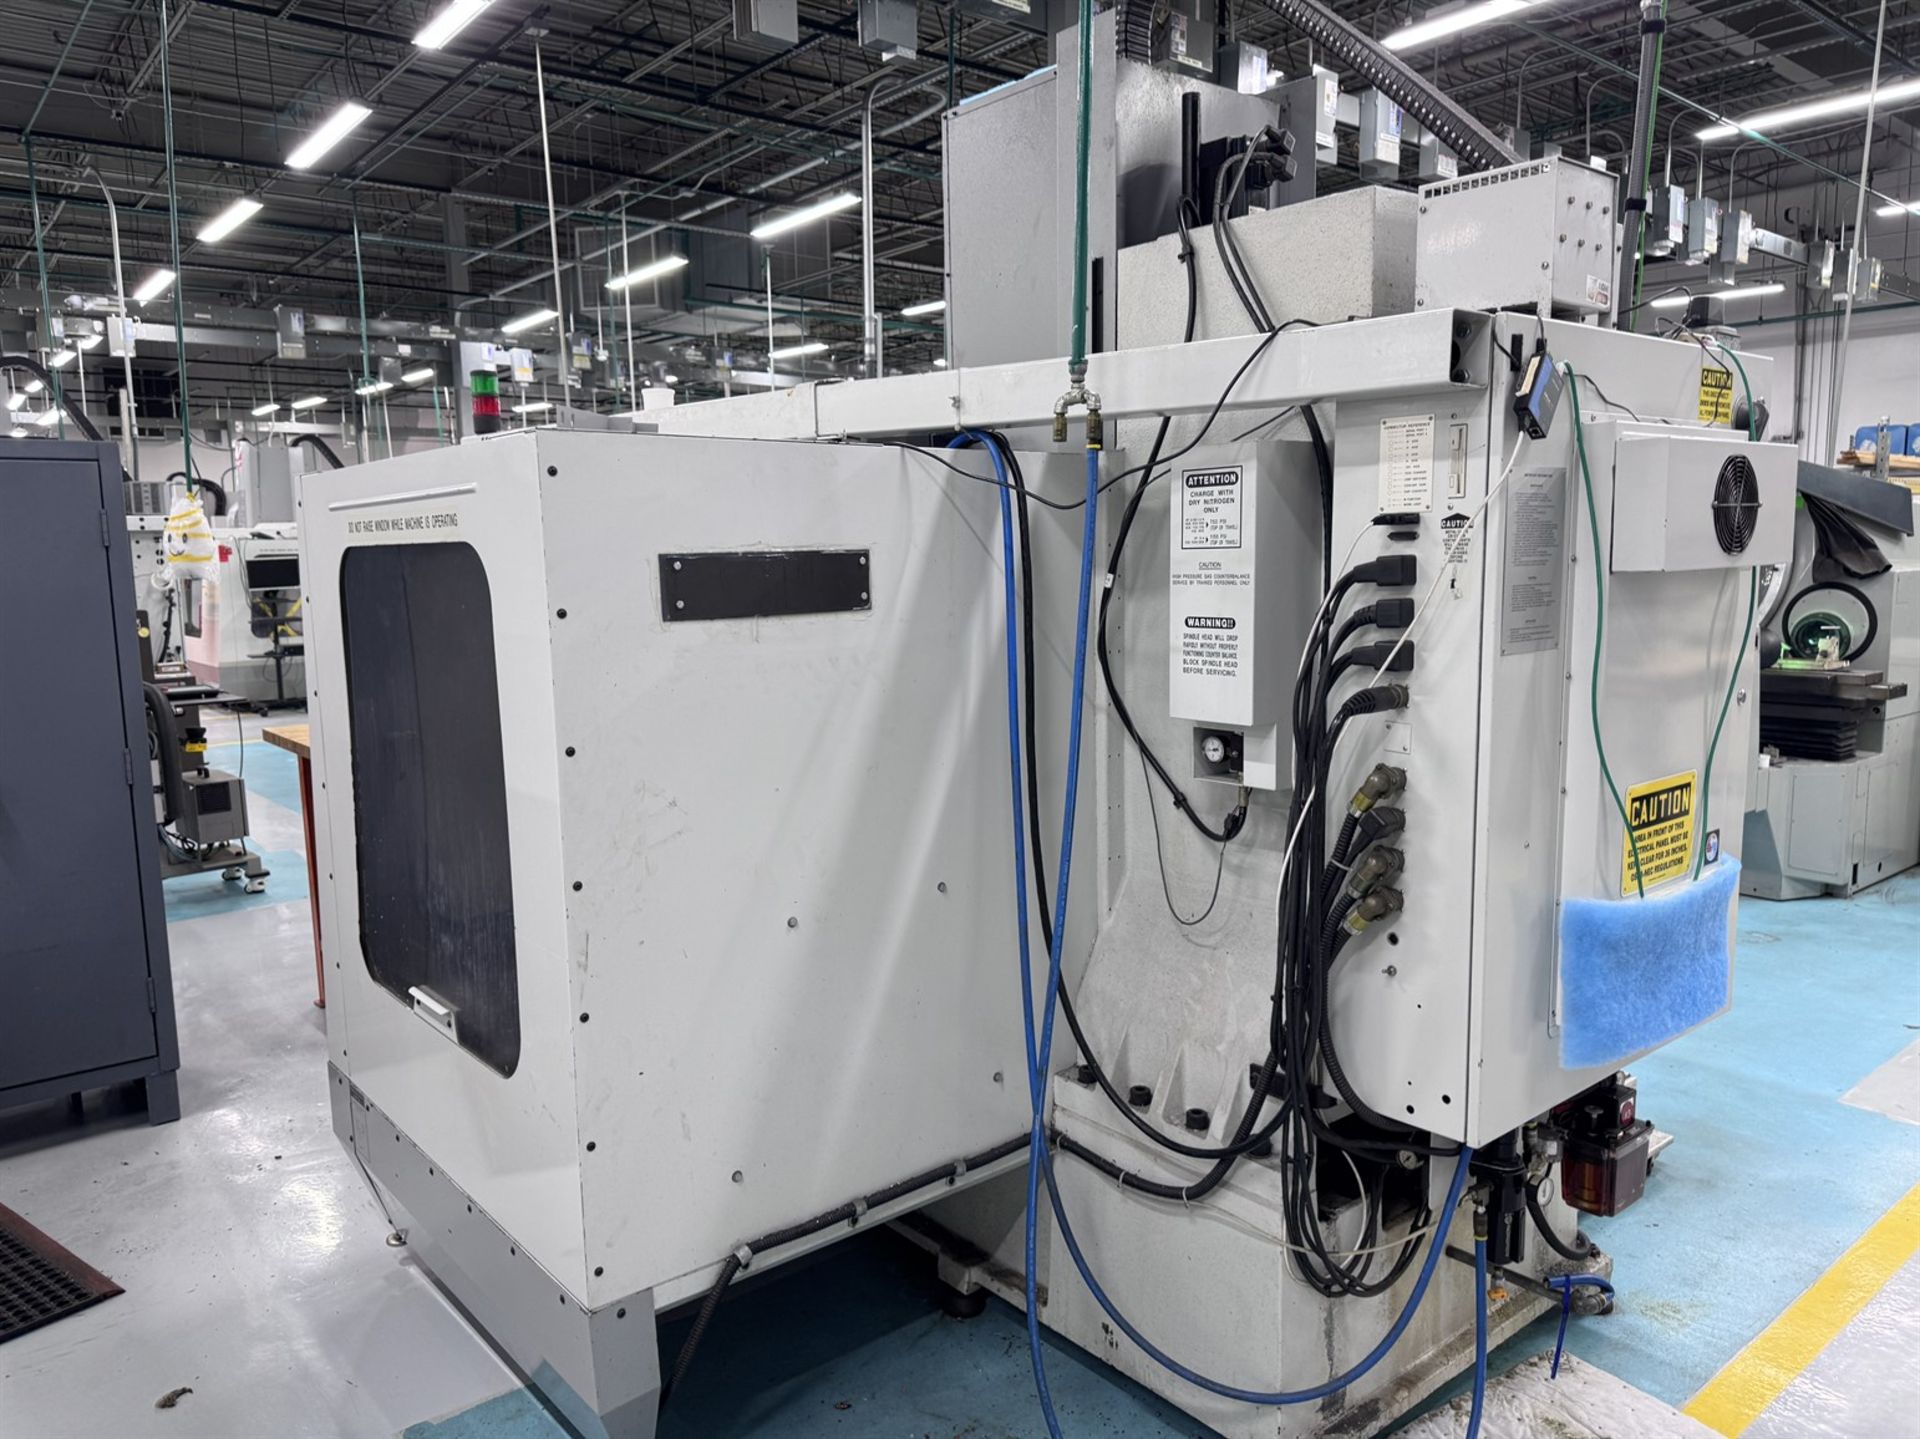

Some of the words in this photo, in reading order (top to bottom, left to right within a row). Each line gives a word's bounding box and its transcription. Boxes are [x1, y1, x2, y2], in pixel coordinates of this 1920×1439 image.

[1188, 473, 1236, 486] ATTENTION
[391, 518, 403, 531] WHILE
[405, 516, 424, 530] MACHINE
[425, 515, 430, 529] IS
[432, 513, 458, 528] OPERATING
[1187, 618, 1233, 627] WARNING!!
[1632, 786, 1690, 827] CAUTION
[1647, 830, 1652, 838] IN
[1653, 826, 1667, 836] FRONT
[1668, 824, 1673, 833] OF
[1675, 821, 1684, 830] THIS
[1656, 837, 1670, 849] PANEL
[1670, 833, 1682, 843] MUST
[1683, 831, 1688, 839] BE
[1640, 854, 1654, 866] CLEAR
[1656, 851, 1664, 859] FOR
[1665, 849, 1670, 857] 36
[1655, 856, 1683, 872] REGULATIONS
